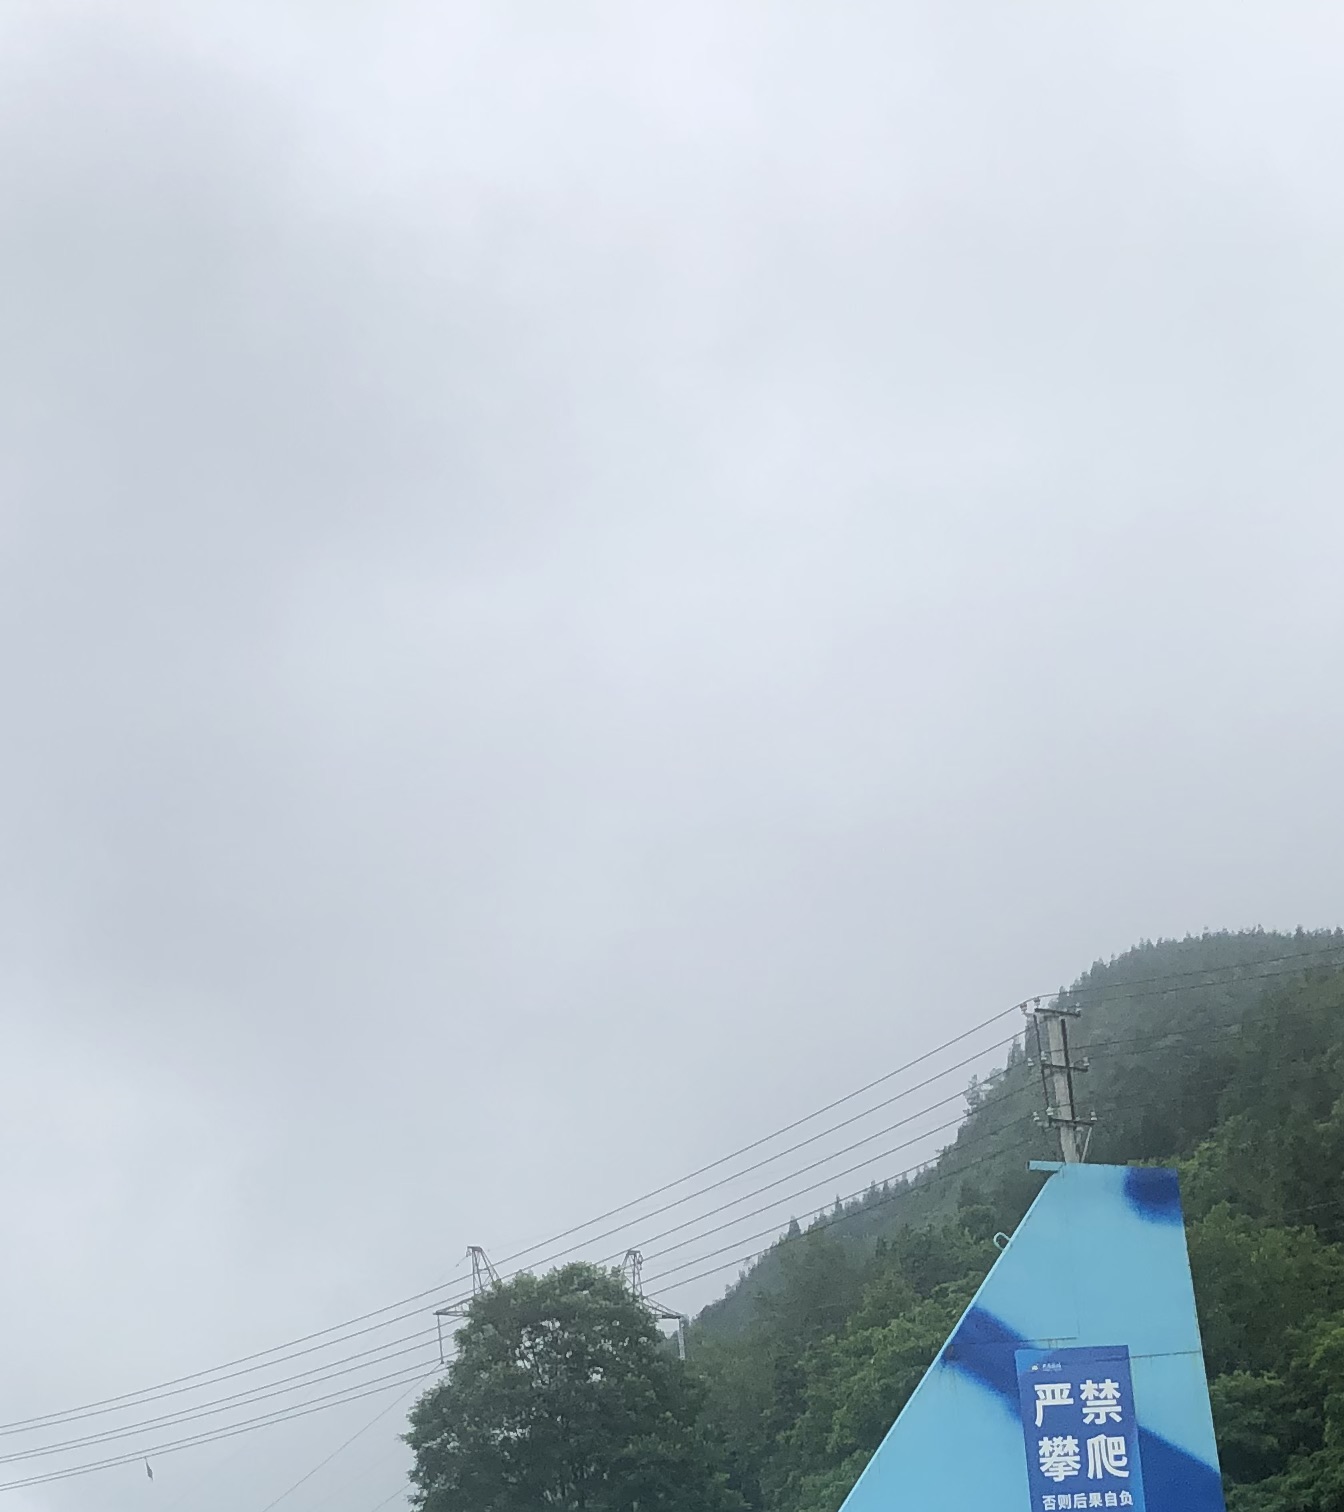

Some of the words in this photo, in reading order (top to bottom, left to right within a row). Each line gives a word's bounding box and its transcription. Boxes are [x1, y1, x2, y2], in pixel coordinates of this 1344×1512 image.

[1033, 1378, 1123, 1427] 严禁
[1038, 1433, 1130, 1482] 攀爬
[1042, 1490, 1134, 1511] 否则后果自负
